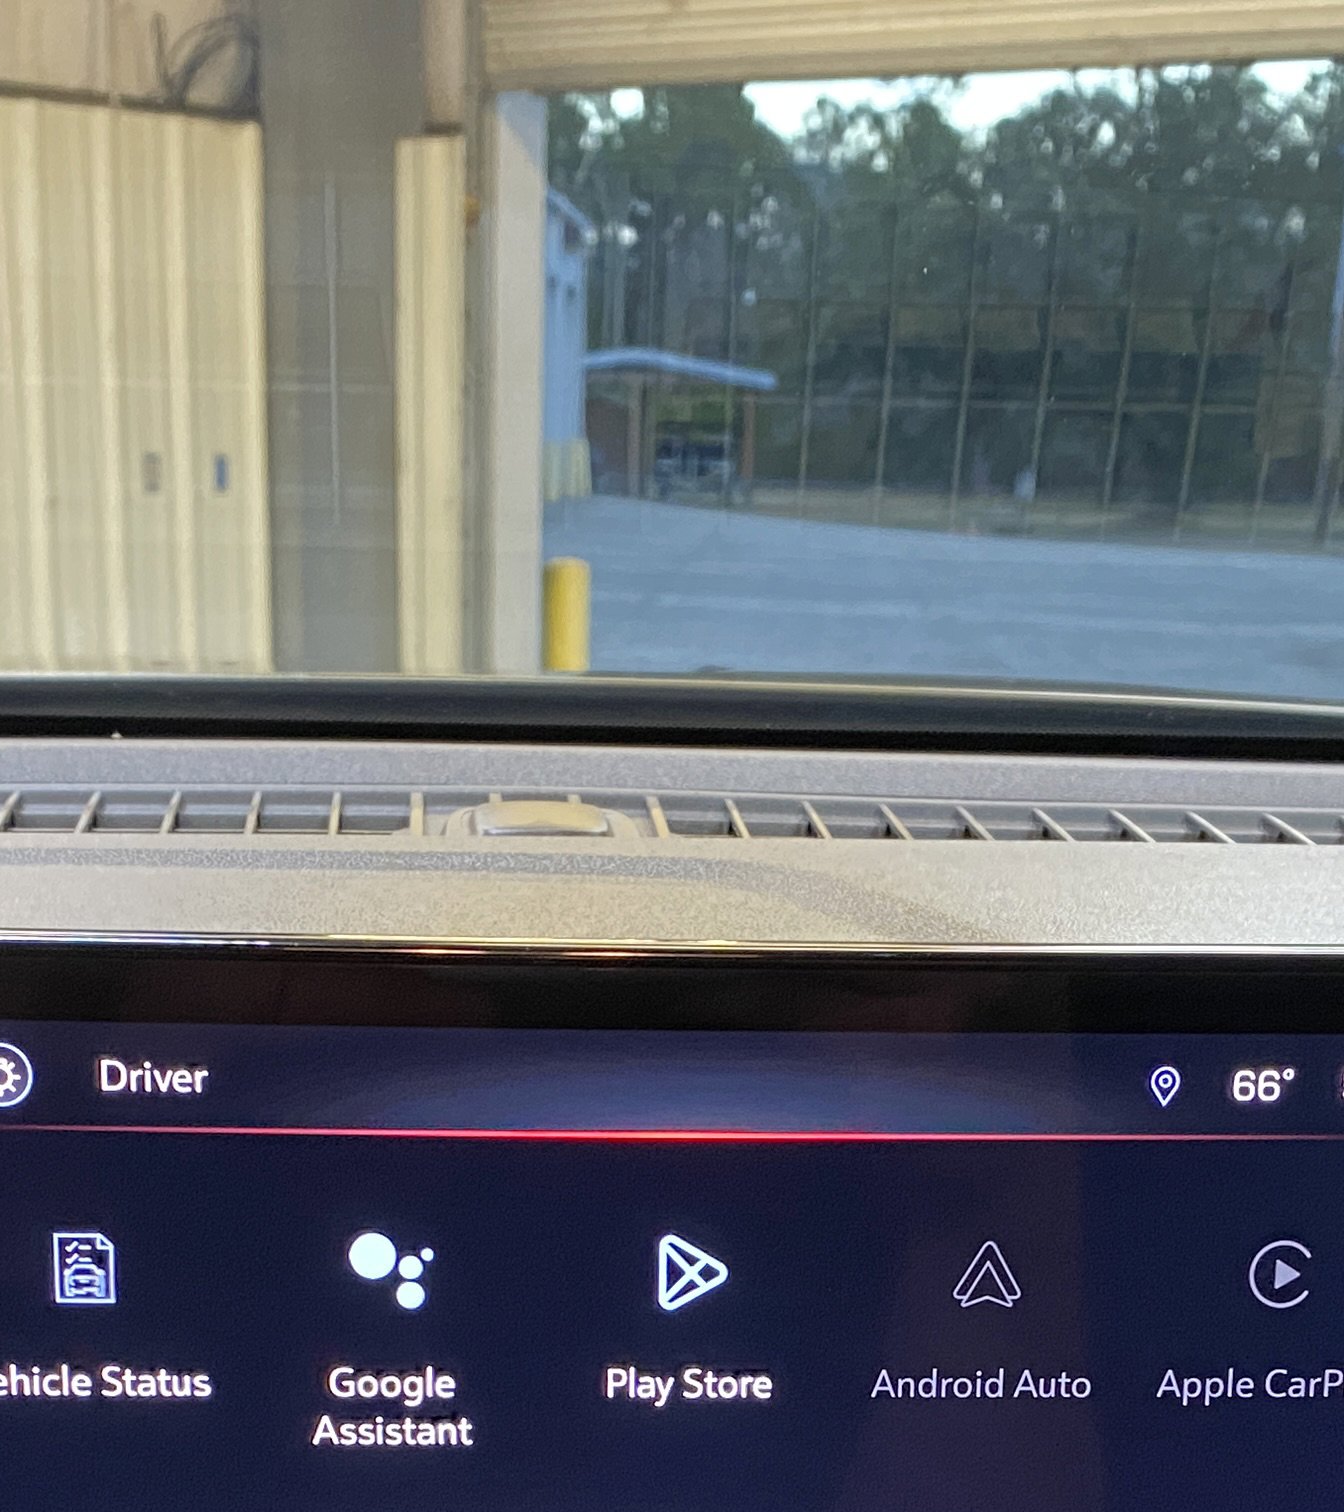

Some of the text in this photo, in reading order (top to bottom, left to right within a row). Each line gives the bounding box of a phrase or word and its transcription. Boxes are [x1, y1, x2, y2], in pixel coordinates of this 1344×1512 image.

[101, 1059, 208, 1093] Driver
[1233, 1068, 1294, 1101] 66°
[101, 1366, 212, 1397] Status
[330, 1366, 455, 1407] Google
[607, 1367, 772, 1407] Play Store
[871, 1368, 1091, 1398] Android Auto
[1157, 1368, 1254, 1406] Apple
[313, 1415, 473, 1445] Assistant
